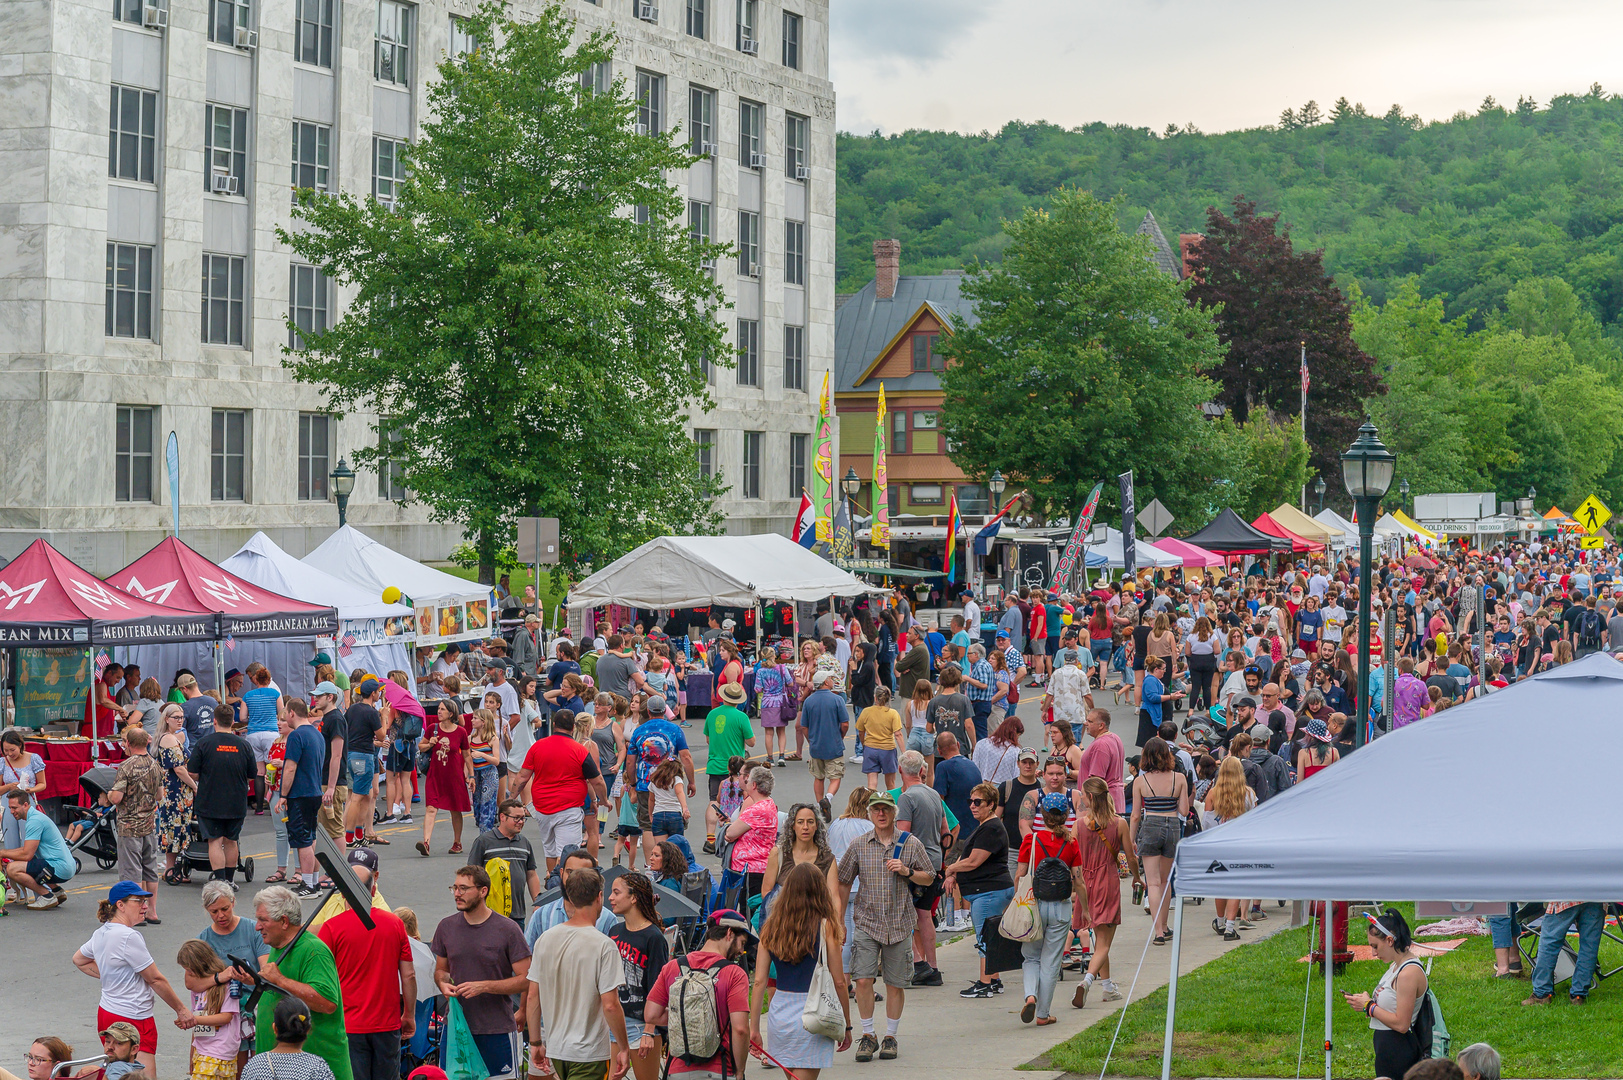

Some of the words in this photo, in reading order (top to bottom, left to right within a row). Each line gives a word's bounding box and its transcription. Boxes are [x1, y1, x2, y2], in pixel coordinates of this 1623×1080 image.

[799, 517, 808, 535] AT
[1053, 517, 1086, 583] TACOS
[102, 623, 185, 639] MEDITERRANEAN
[187, 622, 206, 636] MIX
[231, 617, 308, 633] MEDITERRANEAN
[311, 616, 329, 629] MIX
[0, 628, 31, 641] EAN
[38, 627, 72, 641] MIX
[44, 706, 61, 720] Thank
